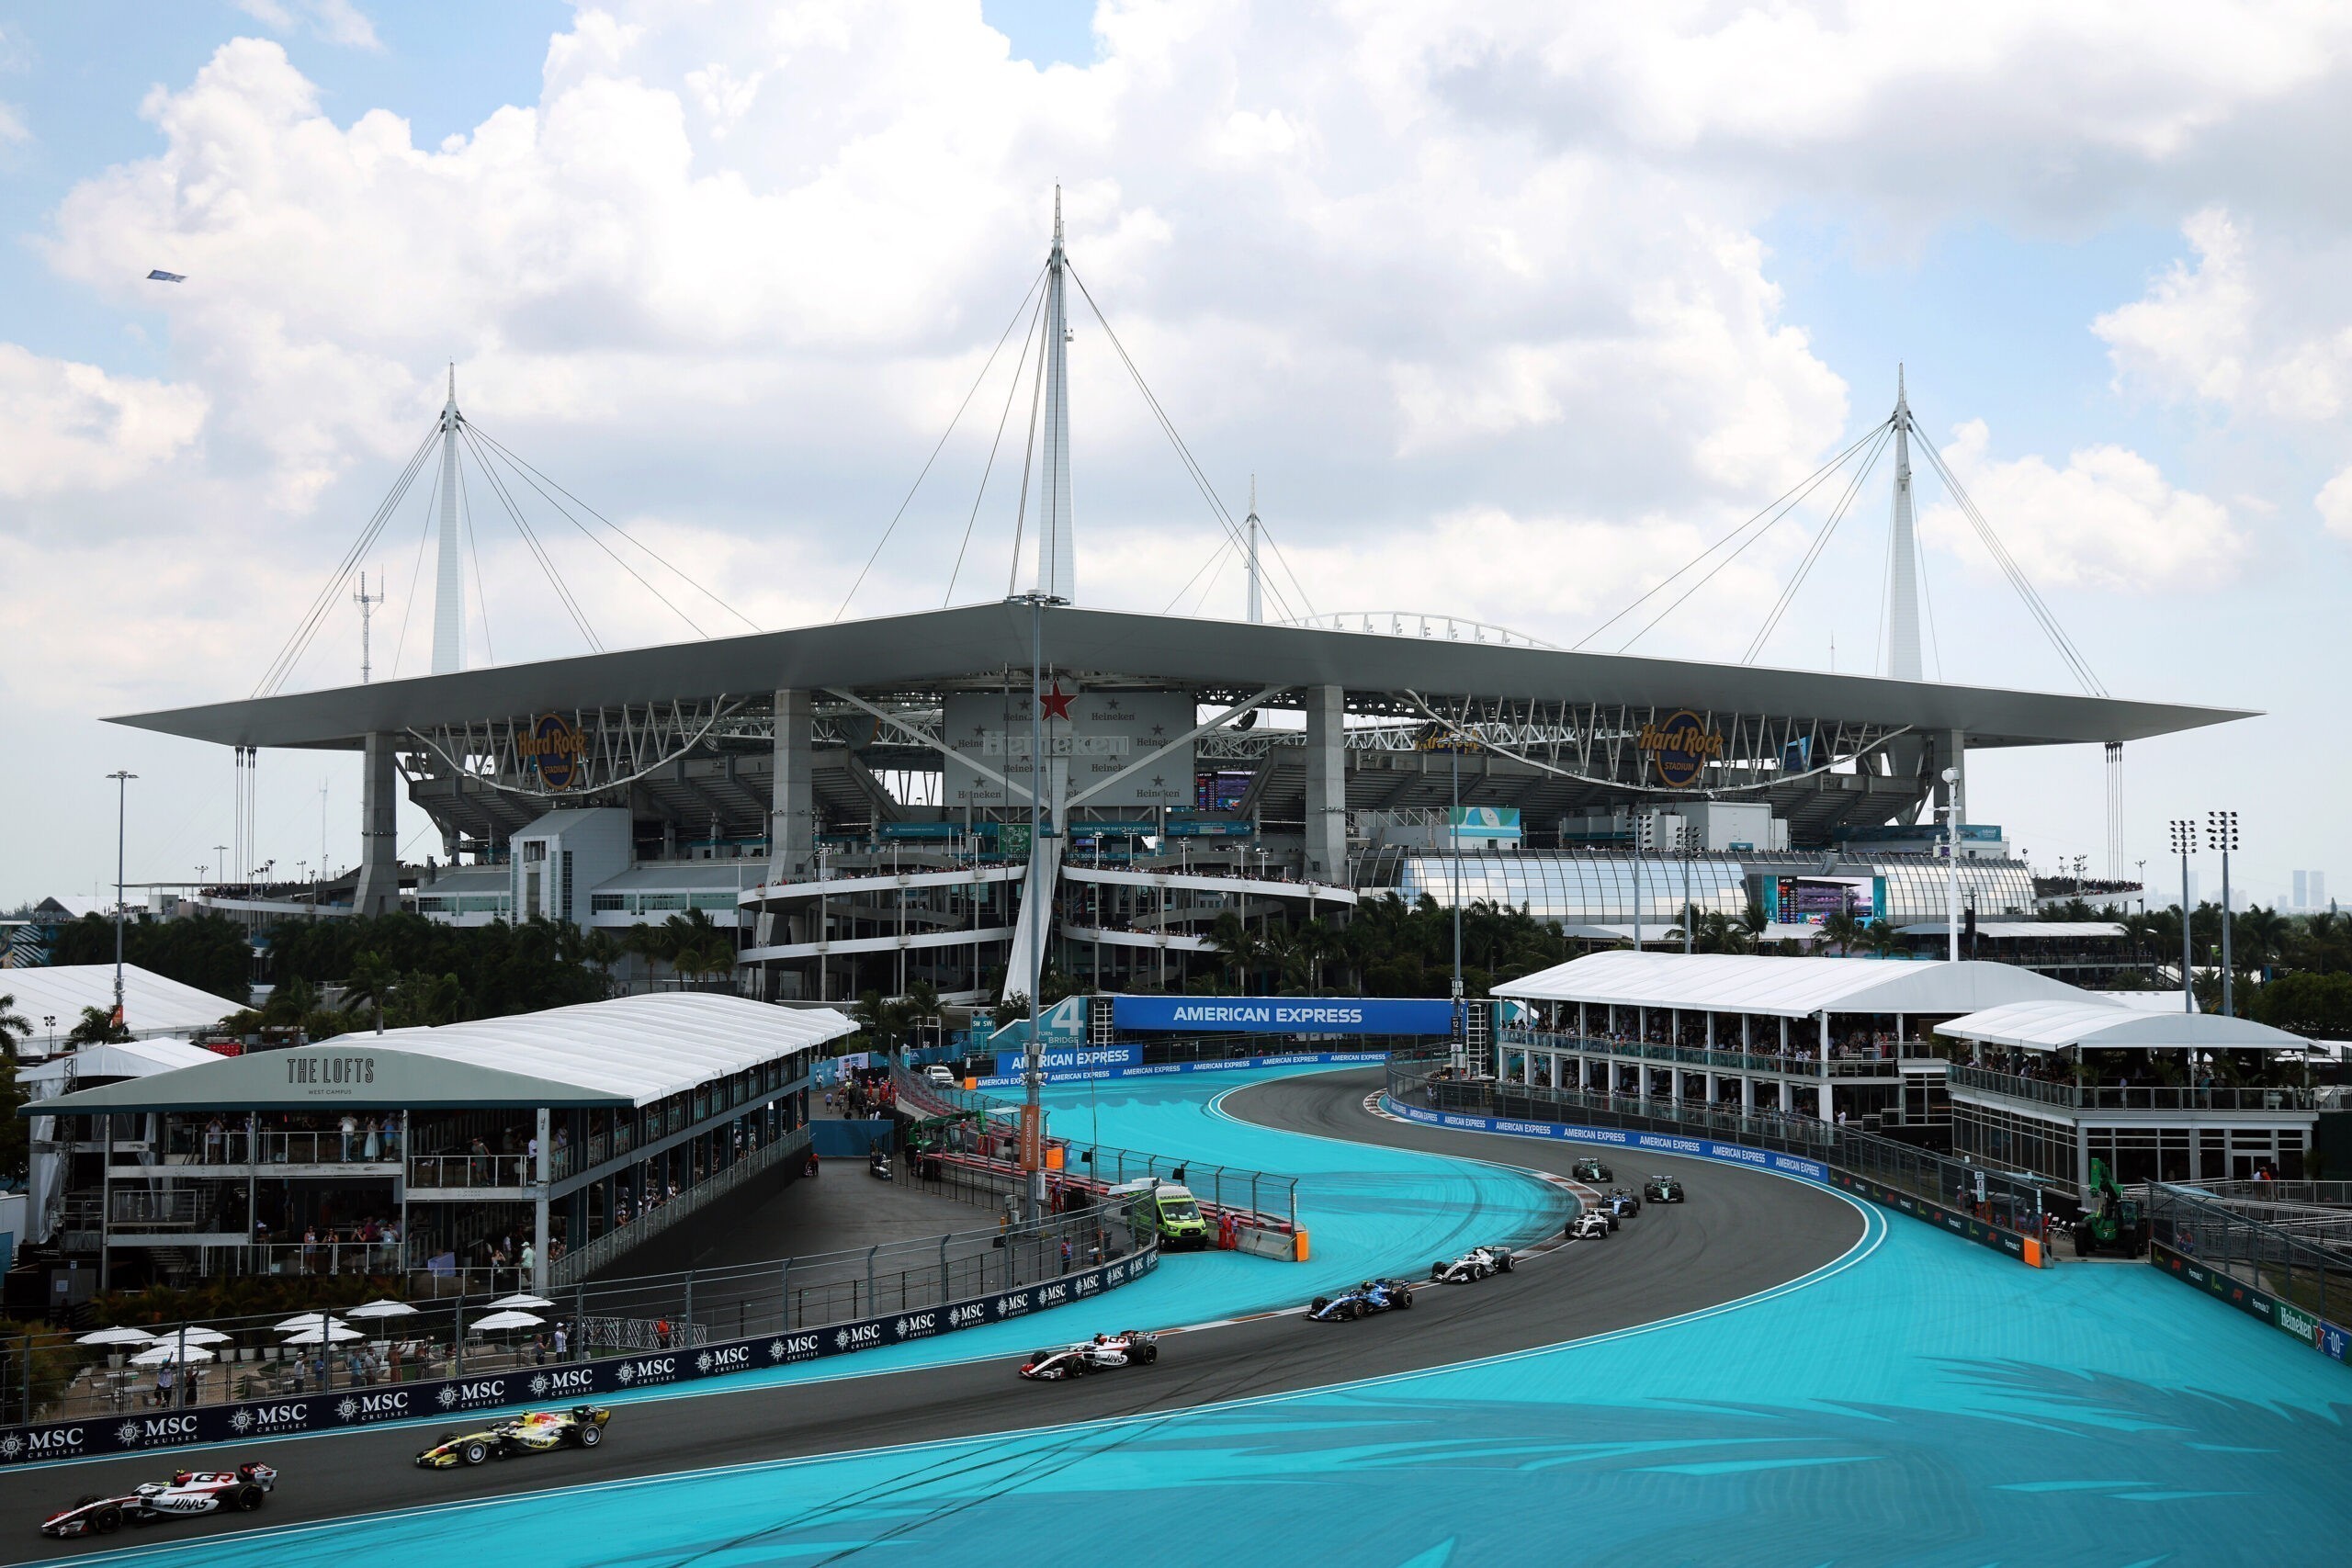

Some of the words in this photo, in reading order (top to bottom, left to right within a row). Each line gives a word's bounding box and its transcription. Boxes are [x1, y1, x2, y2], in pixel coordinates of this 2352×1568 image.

[1091, 713, 1136, 721] Heineken
[517, 728, 551, 757] Hard
[551, 727, 588, 760] Rock
[1639, 724, 1685, 750] Hard
[1683, 727, 1724, 759] Rock
[1663, 761, 1695, 771] STADIUM
[1051, 998, 1084, 1036] 4
[1173, 1007, 1270, 1022] AMERICAN
[1276, 1008, 1363, 1023] EXPRESS
[1077, 1049, 1130, 1066] EXPRESS
[1193, 1062, 1223, 1071] AMERICAN
[1224, 1060, 1250, 1068] EXPRESS
[1262, 1057, 1292, 1066] AMERICAN
[1293, 1055, 1318, 1064] EXPRESS
[287, 1058, 317, 1083] THE
[323, 1057, 374, 1083] LOFTS
[1050, 1072, 1082, 1081] AMERICAN
[1083, 1070, 1110, 1079] EXPRESS
[1123, 1066, 1152, 1076] AMERICAN
[1154, 1066, 1181, 1074] EXPRESS
[977, 1077, 1009, 1087] AMERICAN
[1444, 1116, 1464, 1126] AMERICAN
[1465, 1119, 1486, 1129] EXPRESS
[1496, 1122, 1523, 1133] AMERICAN
[1524, 1123, 1551, 1134] EXPRESS
[1564, 1128, 1596, 1140] AMERICAN
[1597, 1131, 1625, 1143] EXPRESS
[1640, 1135, 1671, 1148] AMERICAN
[1673, 1140, 1700, 1152] EXPRESS
[1712, 1145, 1741, 1159] AMERICAN
[1742, 1150, 1766, 1164] EXPRESS
[1776, 1156, 1800, 1171] AMERICAN
[1801, 1162, 1820, 1177] EXPRESS
[1112, 1265, 1125, 1280] MSC
[1083, 1274, 1099, 1291] MSC
[1046, 1283, 1067, 1301] MSC
[1008, 1293, 1028, 1310] MSC
[960, 1303, 984, 1321] MSC
[909, 1313, 935, 1331] MSC
[2280, 1306, 2312, 1340] Heineken
[851, 1324, 880, 1342] MSC
[786, 1335, 818, 1354] MSC
[851, 1339, 881, 1349] CRUISES
[715, 1347, 749, 1365] MSC
[786, 1350, 819, 1361] CRUISES
[638, 1358, 675, 1377] MSC
[715, 1362, 750, 1373] CRUISES
[551, 1369, 593, 1389] MSC
[638, 1374, 676, 1384] CRUISES
[461, 1380, 504, 1401] MSC
[551, 1386, 594, 1396] CRUISES
[362, 1392, 409, 1413] MSC
[461, 1397, 504, 1408] CRUISES
[256, 1404, 307, 1424] MSC
[361, 1410, 409, 1421] CRUISES
[145, 1416, 198, 1437] MSC
[256, 1422, 307, 1433] CRUISES
[28, 1427, 84, 1450] MSC
[144, 1434, 198, 1446] CRUISES
[527, 1438, 548, 1447] VISA
[28, 1448, 84, 1459] CRUISES
[194, 1472, 232, 1483] GR
[170, 1498, 209, 1511] HAAS
